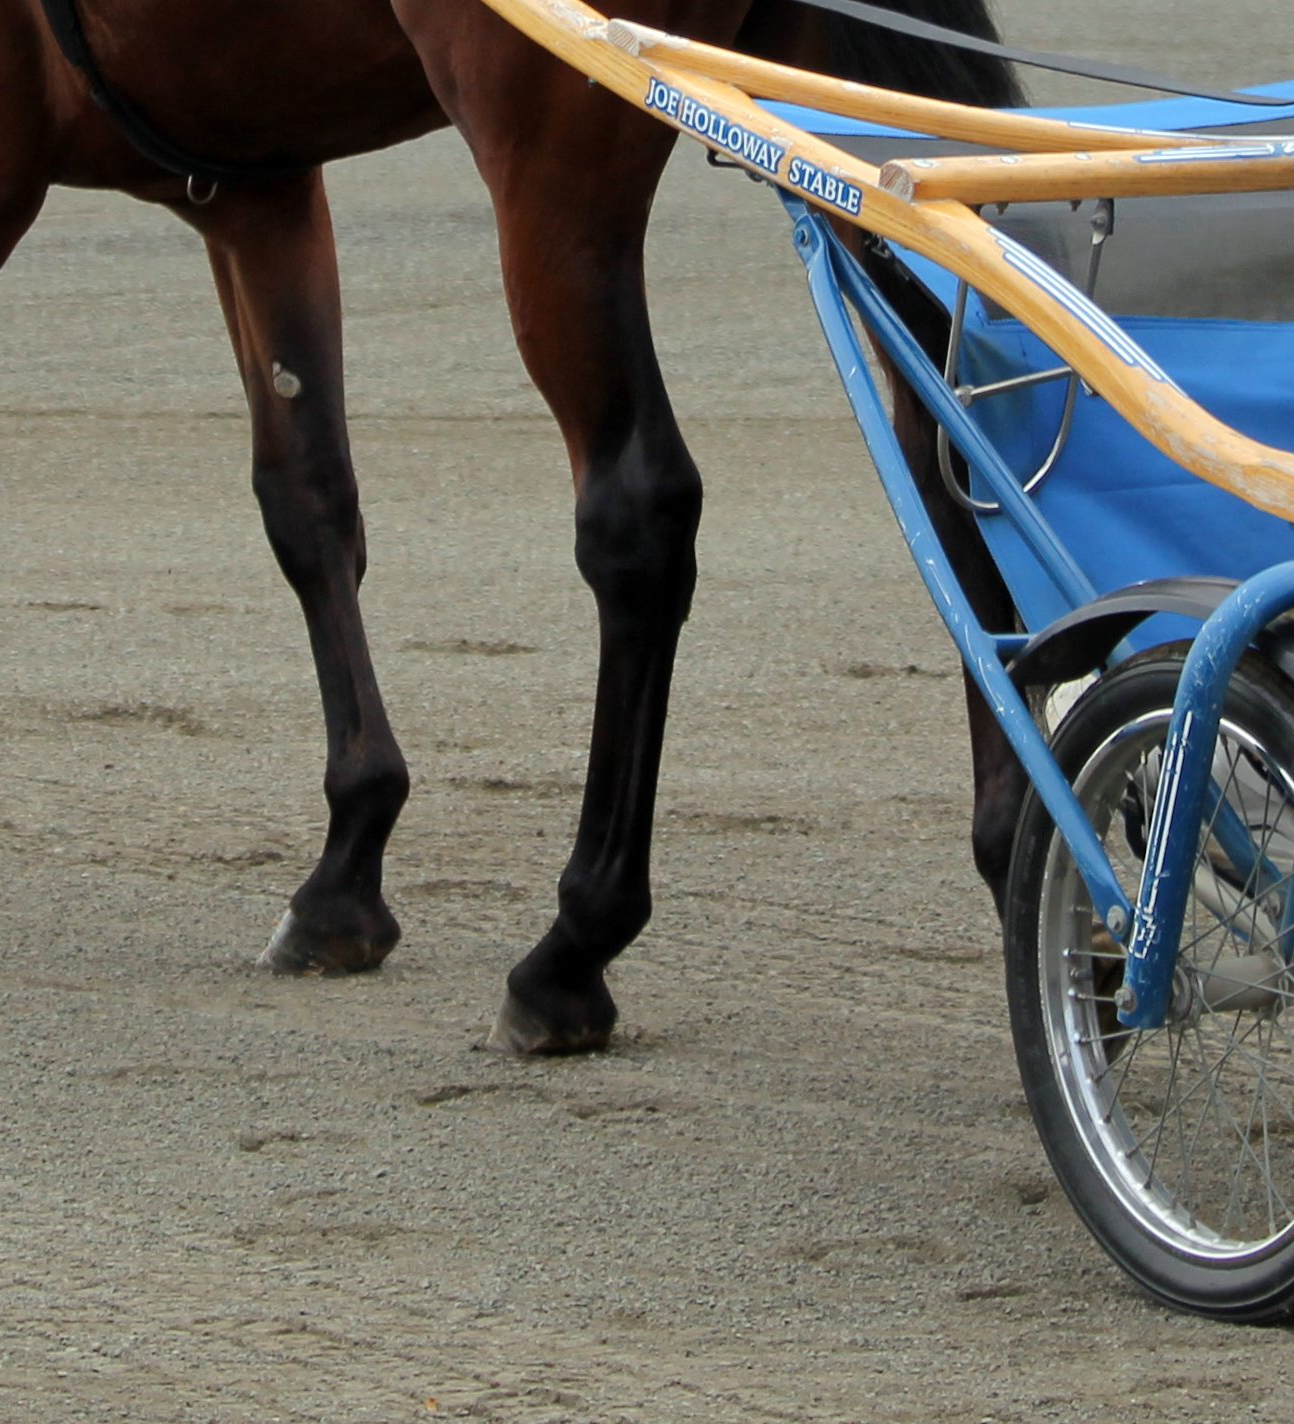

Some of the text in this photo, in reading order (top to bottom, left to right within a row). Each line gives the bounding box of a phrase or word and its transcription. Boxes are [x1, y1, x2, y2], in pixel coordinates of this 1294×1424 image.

[646, 79, 862, 213] JOE HOLLOWAY STABLE
